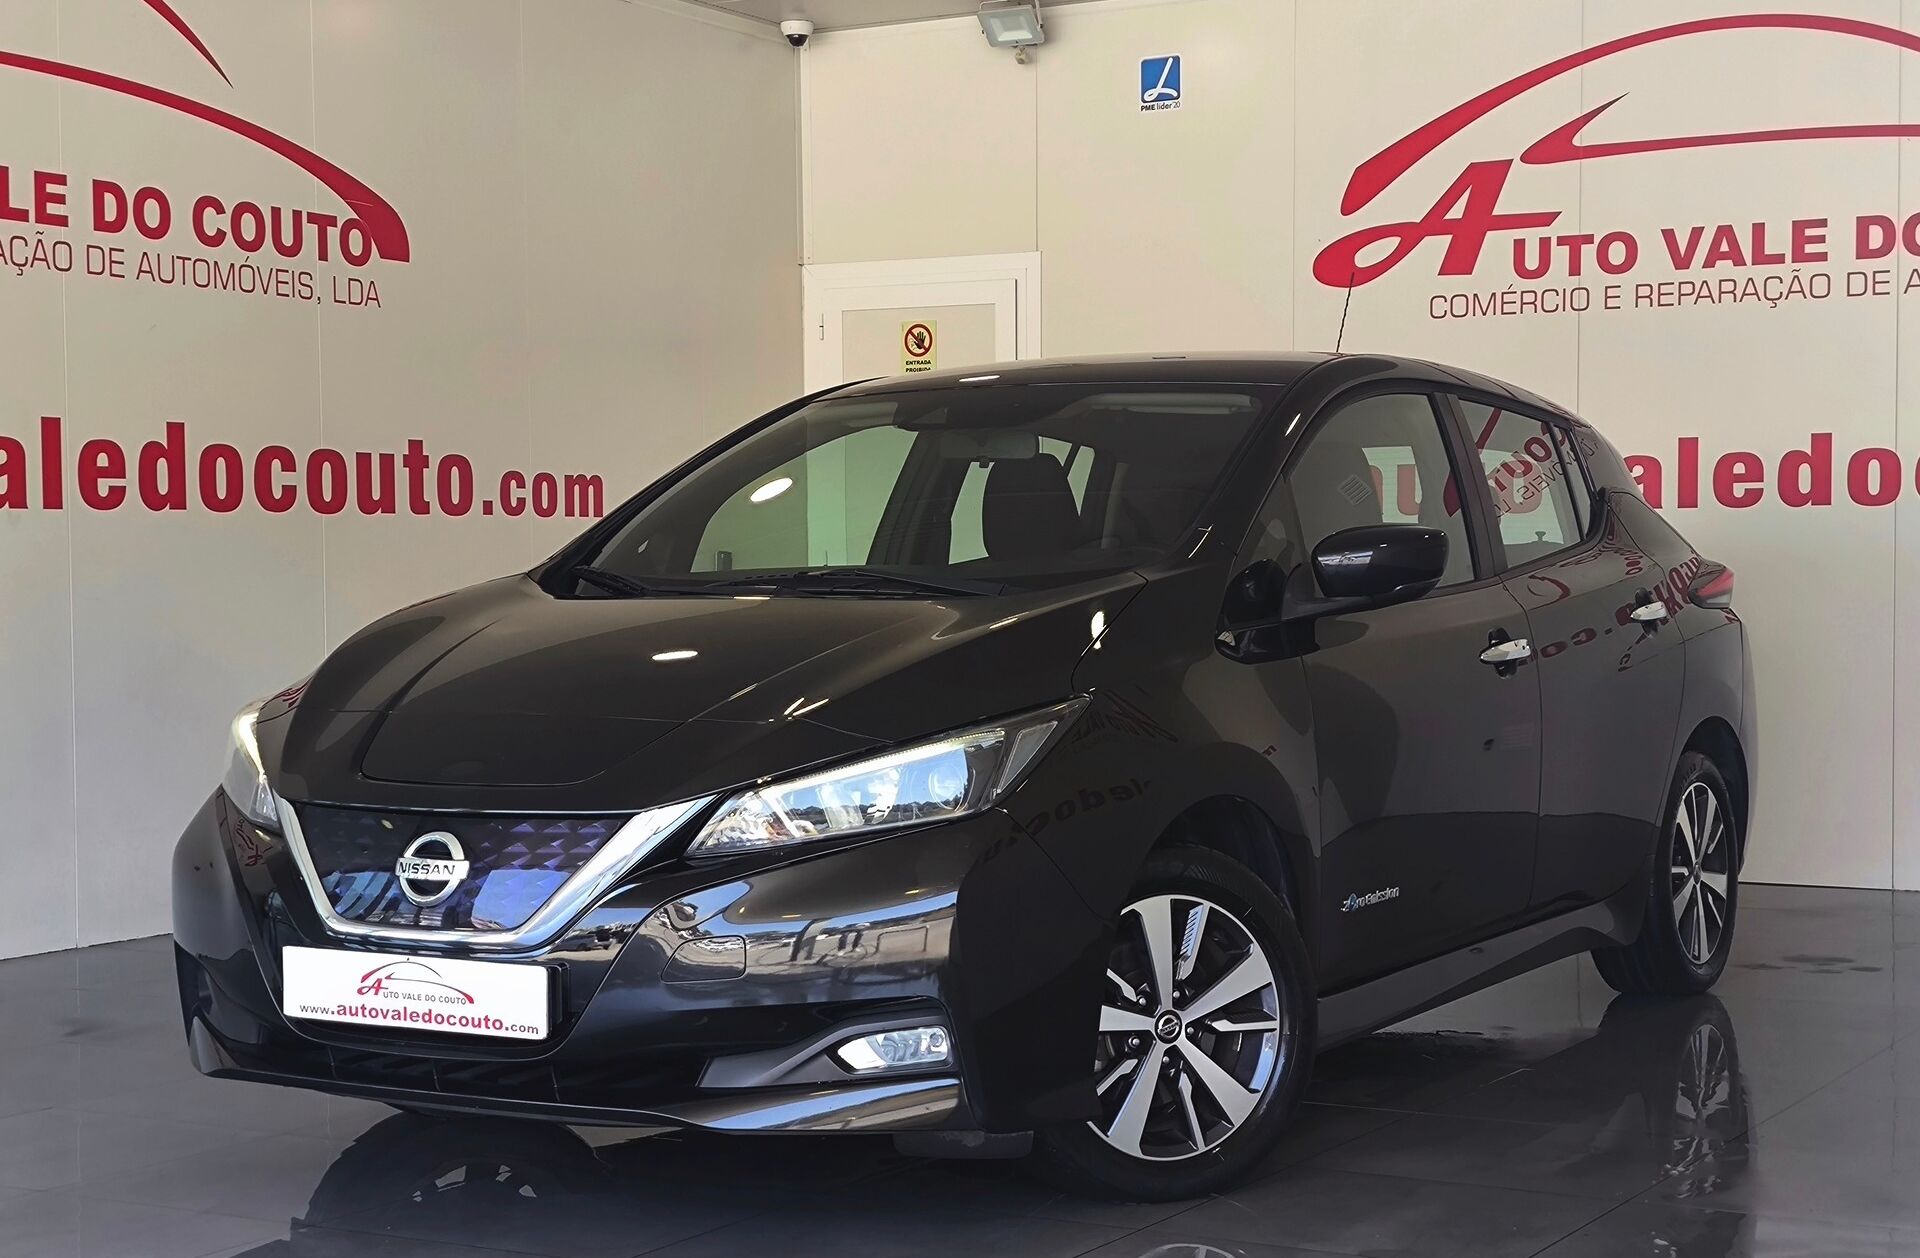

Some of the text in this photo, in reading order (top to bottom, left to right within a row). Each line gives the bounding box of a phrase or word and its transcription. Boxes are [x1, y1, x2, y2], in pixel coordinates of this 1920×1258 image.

[92, 179, 171, 240] DO
[193, 196, 373, 267] COUTO
[1661, 218, 1828, 271] VALE
[86, 244, 126, 279] DE
[136, 251, 321, 304] AUTOMÓVEIS,
[332, 275, 382, 309] LDA
[1429, 284, 1590, 319] COMÉRCIO
[1604, 284, 1622, 310] E
[1635, 268, 1831, 309] REPARAÇÃO
[1846, 270, 1891, 297] DE
[399, 861, 455, 875] NISSAN
[299, 1003, 538, 1035] www.autovaledocouto.com
[401, 992, 422, 1001] VALE
[424, 994, 437, 1002] DO
[438, 995, 467, 1006] COUTO
